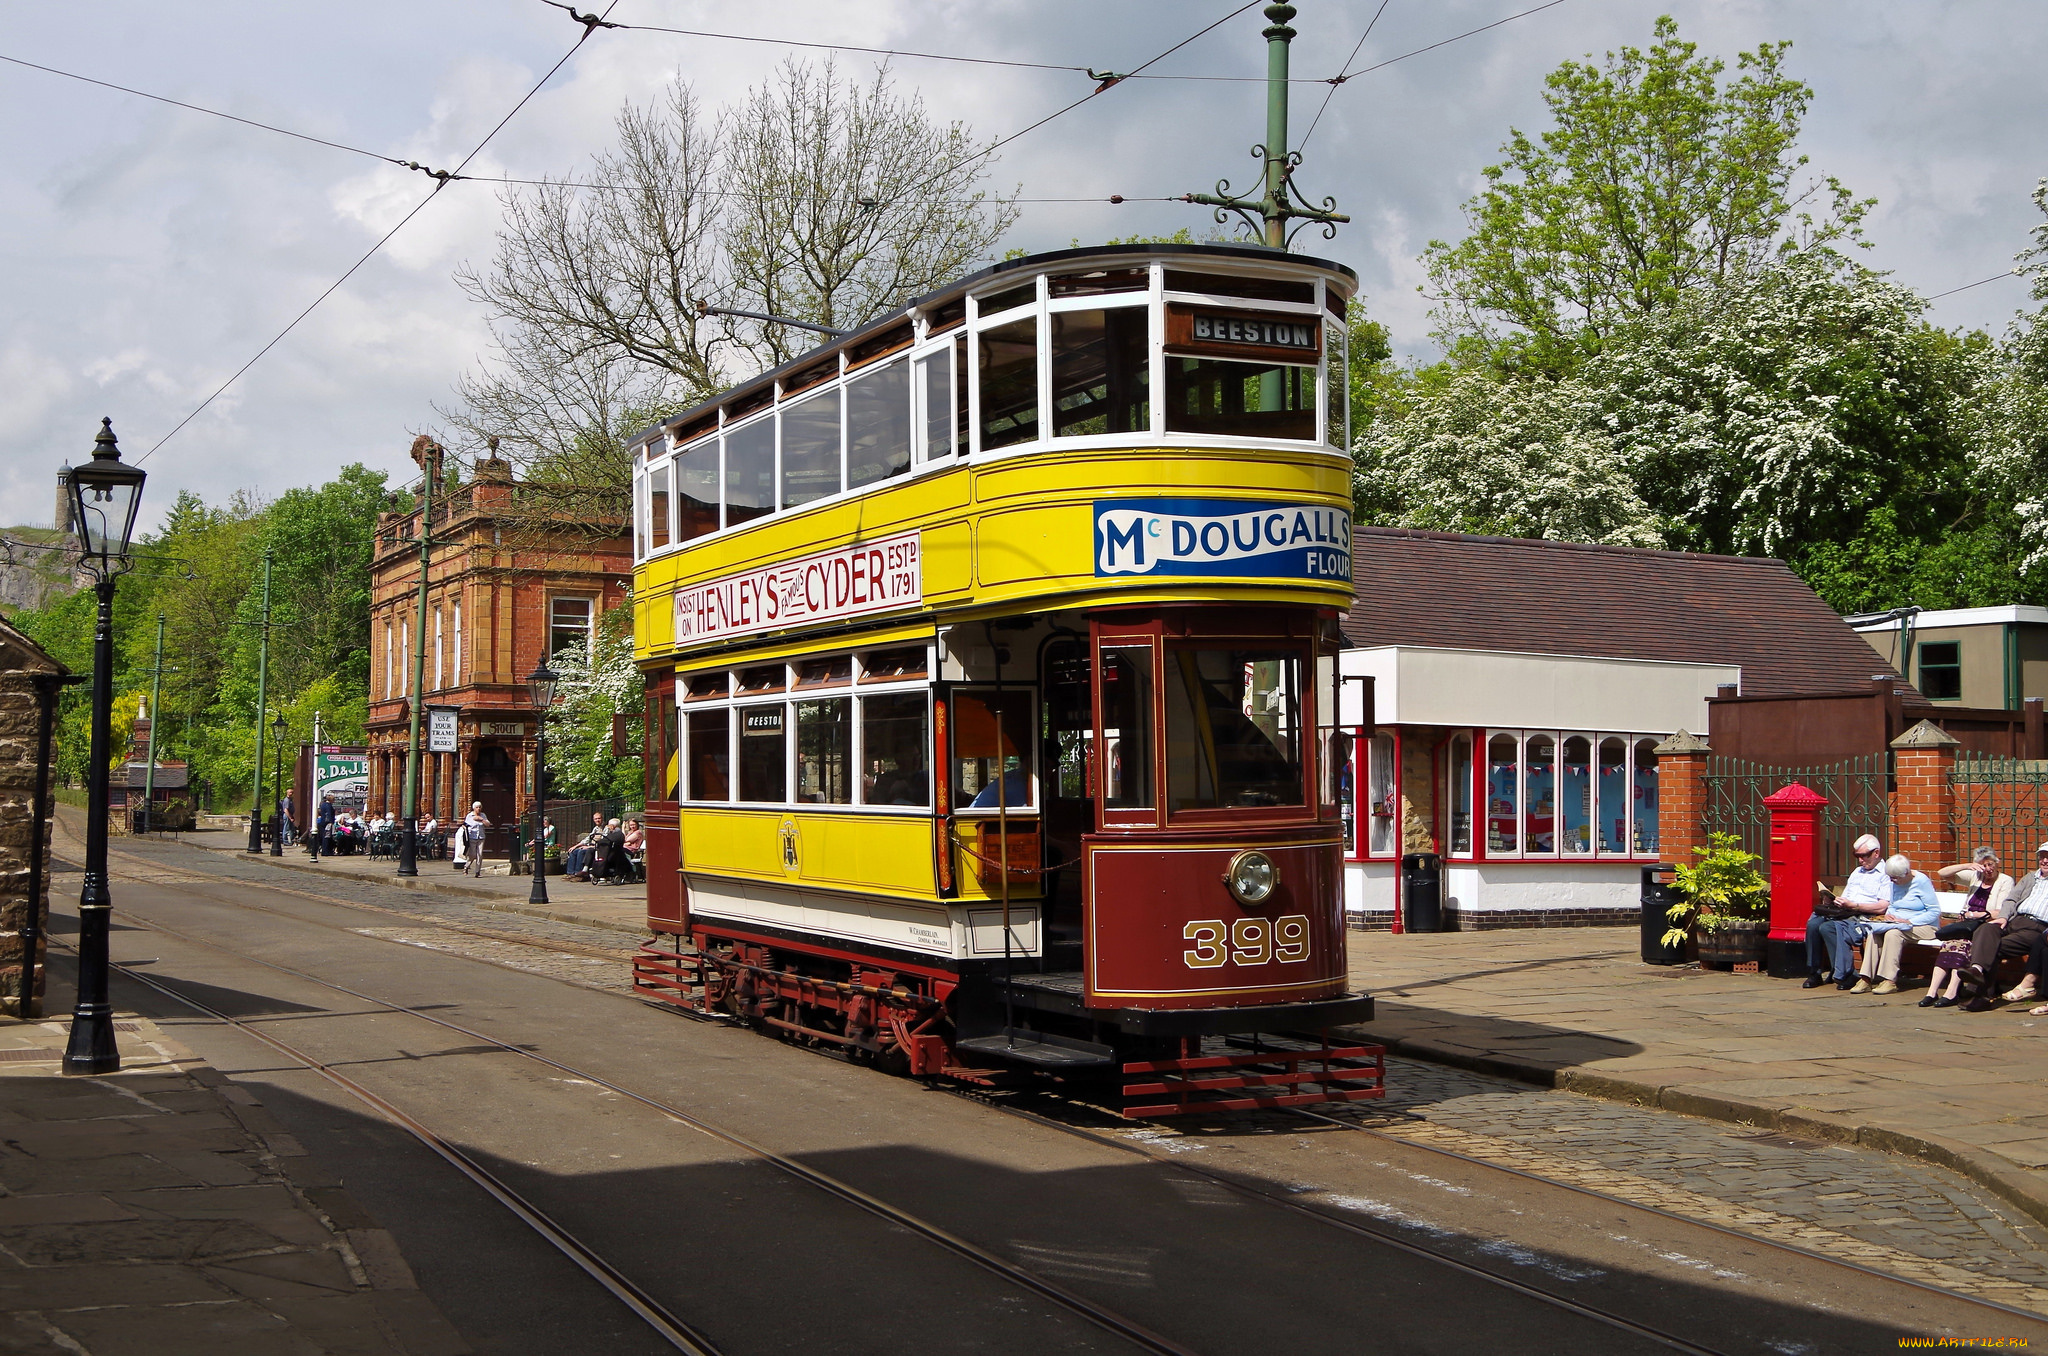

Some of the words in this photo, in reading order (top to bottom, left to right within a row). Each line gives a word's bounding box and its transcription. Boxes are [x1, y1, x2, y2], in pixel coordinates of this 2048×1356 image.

[1195, 317, 1308, 346] BEESTON
[1307, 552, 1350, 577] FLOUR
[696, 572, 779, 633] HENLEY'S
[781, 569, 804, 616] FAMOUS
[805, 549, 886, 612] CYDER
[891, 571, 915, 598] 1791
[677, 593, 695, 616] INSIST
[682, 618, 691, 636] ON
[1183, 914, 1310, 969] 399
